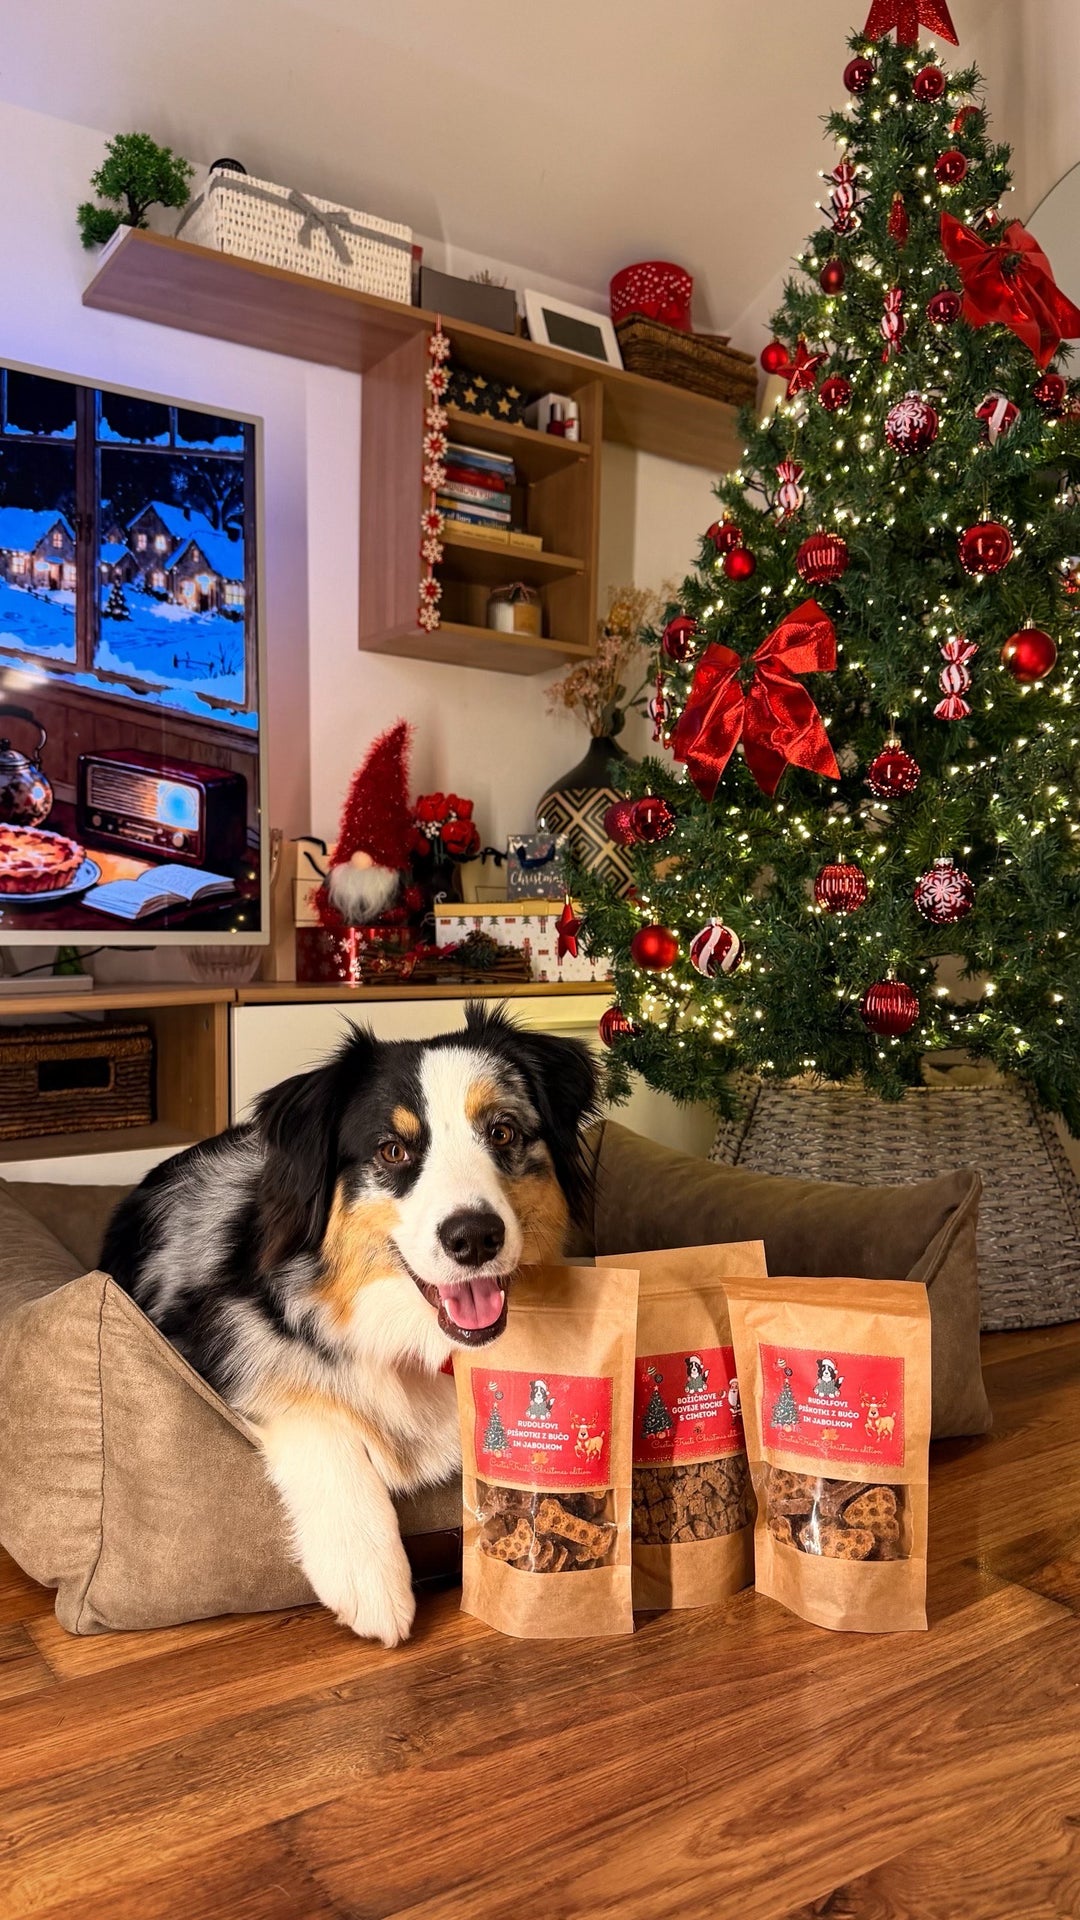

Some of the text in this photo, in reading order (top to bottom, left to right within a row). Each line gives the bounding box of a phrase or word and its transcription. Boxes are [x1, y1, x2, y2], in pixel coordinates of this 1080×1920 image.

[678, 1393, 716, 1404] BOŽIČKOVE
[808, 1397, 848, 1407] RUDOLFOVI
[672, 1400, 723, 1414] GOVEJE KOCKE
[799, 1405, 830, 1416] PIŠKOTKI
[838, 1409, 859, 1418] BUČO
[685, 1410, 717, 1420] CIMETOM
[518, 1421, 558, 1430] RUDOLFOVI
[812, 1418, 852, 1428] JABOLKOM
[507, 1429, 541, 1438] PIŠKOTKI
[548, 1432, 569, 1440] BUČO
[696, 1432, 728, 1443] Christmas
[522, 1441, 562, 1450] JABOLKOM
[821, 1439, 859, 1451] Christmas
[532, 1464, 568, 1475] Christmas
